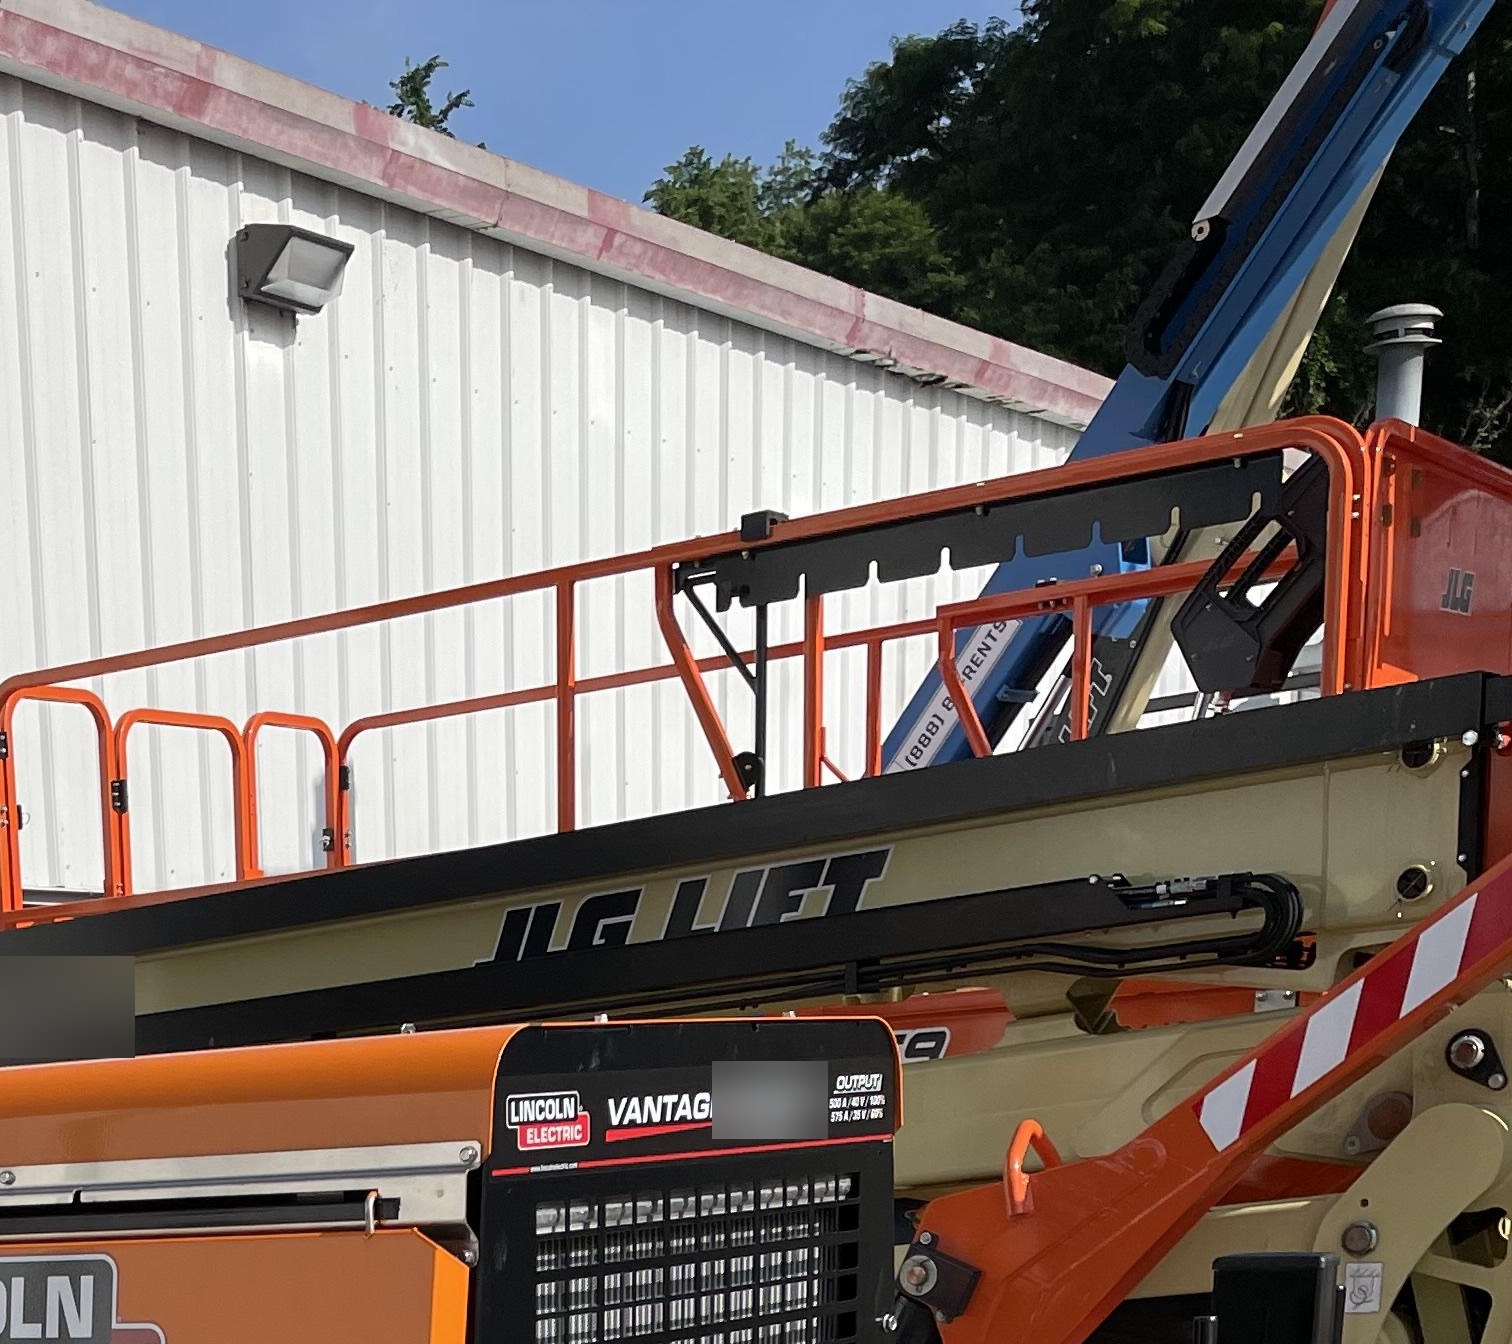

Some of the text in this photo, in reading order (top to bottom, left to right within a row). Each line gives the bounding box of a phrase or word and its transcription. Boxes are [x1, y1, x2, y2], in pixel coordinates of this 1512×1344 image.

[1440, 567, 1475, 616] JLG
[905, 619, 1008, 768] (888) 8-RENTS
[661, 846, 895, 942] LIFT
[835, 1073, 881, 1090] OUTPUT
[510, 1097, 576, 1124] LINCOLN
[607, 1091, 713, 1126] VANTAG
[526, 1124, 583, 1144] ELECTRIC
